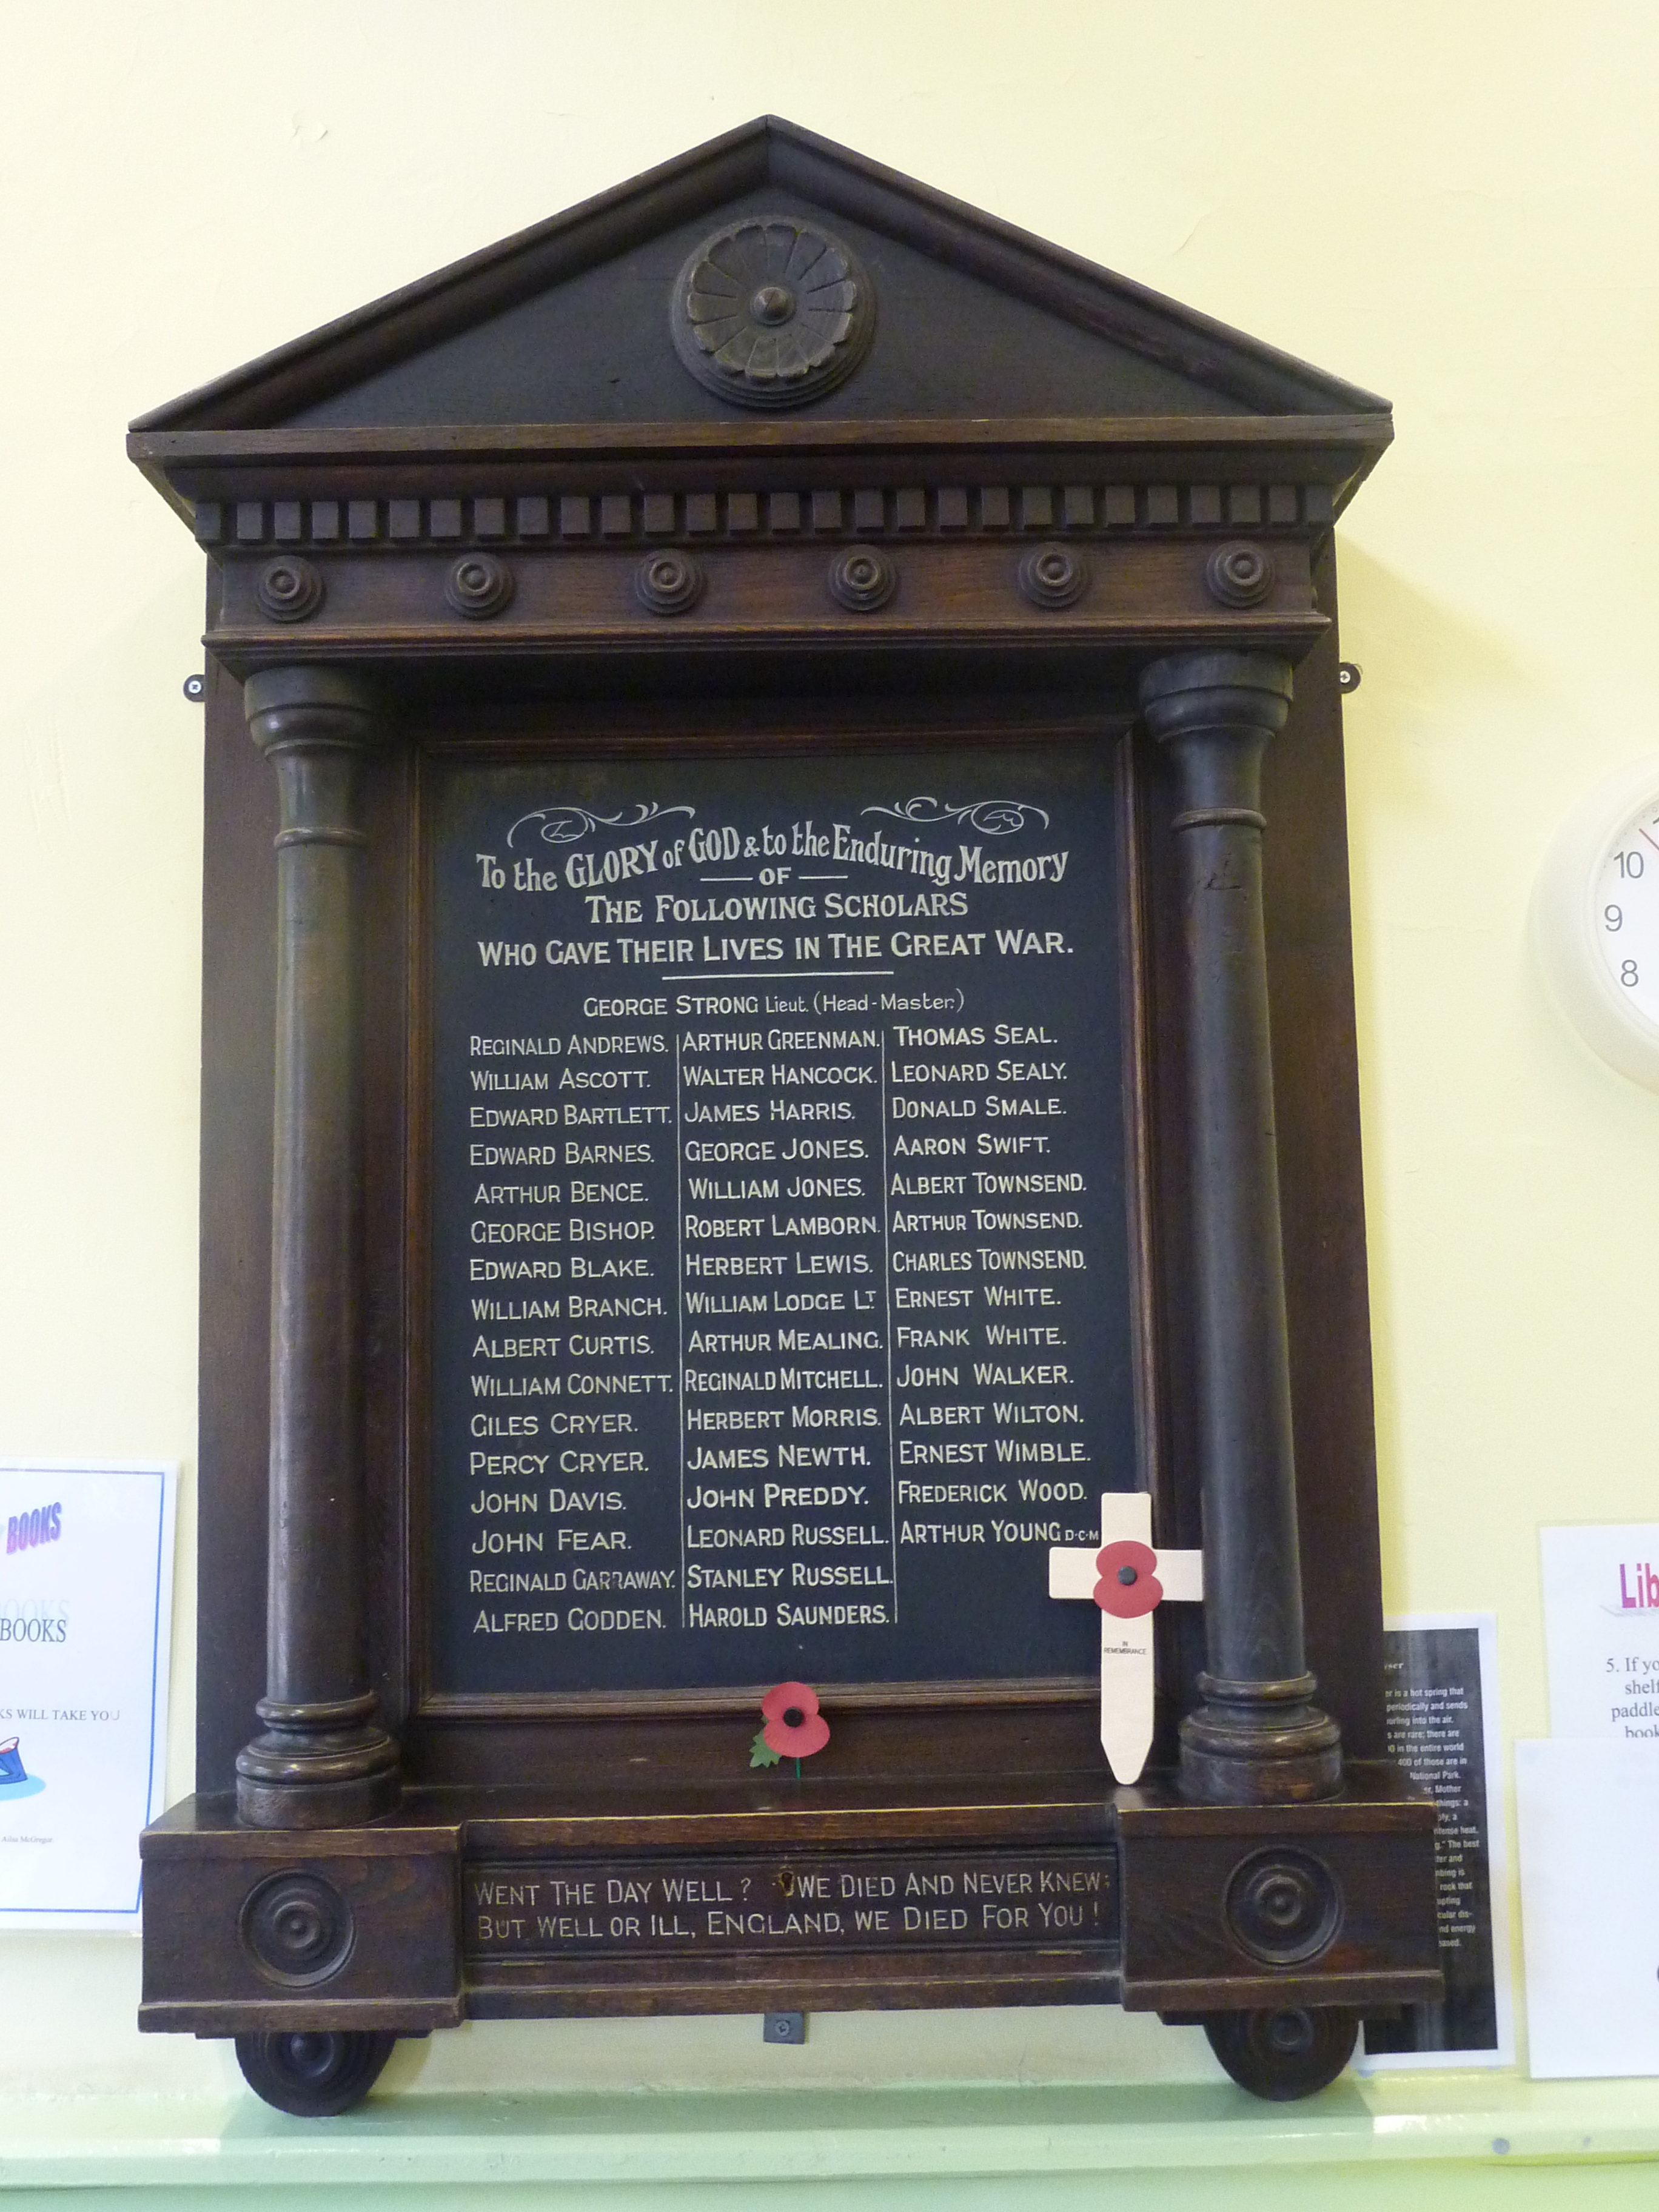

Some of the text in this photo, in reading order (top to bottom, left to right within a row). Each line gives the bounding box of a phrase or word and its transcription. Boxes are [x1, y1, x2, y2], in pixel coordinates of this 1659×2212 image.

[476, 821, 1068, 891] To the GLORY of GOD & to the Enduring Memory
[1614, 851, 1644, 879] 10
[759, 867, 791, 885] OF
[585, 892, 968, 923] THE FOLLOWING SCHOLARS
[1604, 905, 1622, 931] 9
[478, 930, 1073, 966] WHO GAVE THEIR LIVES IN THE GREAT WAR.
[1621, 960, 1638, 987] 8
[584, 997, 668, 1017] GEORGE
[676, 995, 758, 1014] STRONG
[766, 996, 808, 1013] Lieut.
[471, 1034, 668, 1056] REGINALD ANDREWS.
[683, 1029, 880, 1051] ARTHUR GREENMAN.
[893, 1024, 1057, 1046] THOMAS SEAL.
[471, 1068, 650, 1090] WILLIAM ASCOTT.
[683, 1064, 877, 1086] WALTER HANCOCK.
[892, 1060, 1067, 1082] LEONARD SEALY.
[471, 1105, 671, 1127] EDWARD BARTLETT.
[685, 1100, 855, 1122] JAMES HARRIS.
[893, 1096, 1066, 1118] DONALD SMALE.
[471, 1142, 654, 1165] EDWARD BARNES.
[685, 1138, 868, 1161] GEORGE JONES.
[894, 1133, 1050, 1156] AARON SWIFT.
[475, 1181, 648, 1204] ARTHUR BENCE.
[689, 1177, 865, 1199] WILLIAM JONES.
[891, 1172, 1086, 1195] ALBERT TOWNSEND.
[471, 1219, 654, 1243] GEORGE BISHOP.
[686, 1215, 880, 1238] ROBERT LAMBORN.
[893, 1210, 1082, 1232] ARTHUR TOWNSEND.
[470, 1258, 654, 1281] EDWARD BLAKE.
[686, 1252, 873, 1275] HERBERT LEWIS.
[893, 1249, 1086, 1272] CHARLES TOWNSEND.
[472, 1296, 667, 1320] WILLIAM BRANCH.
[686, 1292, 767, 1313] WILLIAM
[774, 1292, 845, 1311] LODGE
[896, 1286, 1061, 1308] ERNEST WHITE.
[473, 1335, 654, 1358] ALBERT CURTIS.
[689, 1329, 883, 1352] ARTHUR MEALING.
[897, 1325, 1066, 1347] FRANK WHITE.
[471, 1373, 672, 1396] WILLIAM CONNETT.
[686, 1368, 882, 1391] REGINALD MITCHELL.
[897, 1364, 1073, 1387] JOHN WALKER.
[471, 1413, 637, 1436] GILES CRYER.
[688, 1406, 881, 1430] HERBERT MORRIS.
[900, 1403, 1084, 1426] ALBERT WILTON.
[471, 1450, 648, 1475] PERCY CRYER.
[688, 1445, 870, 1469] JAMES NEWTH.
[900, 1439, 1090, 1464] ERNEST WIMBLE.
[471, 1489, 626, 1513] JOHN DAVIS.
[687, 1484, 868, 1509] JOHN PREDDY.
[899, 1480, 1087, 1504] FREDERICK WOOD.
[6, 1501, 62, 1555] BOOKS
[688, 1524, 889, 1548] LEONARD RUSSELL.
[900, 1521, 985, 1543] ARTHUR
[991, 1520, 1061, 1542] YOUNG
[472, 1529, 631, 1553] JOHN FEAR.
[471, 1570, 566, 1592] REGINALD
[688, 1563, 893, 1587] STANLEY RUSSELL.
[1620, 1563, 1659, 1608] Lib
[474, 1607, 666, 1632] ALFRED GODDEN.
[689, 1603, 889, 1627] HAROLD SAUNDERS.
[0, 1618, 67, 1643] BOOKS
[1606, 1658, 1620, 1672] 5.
[1625, 1657, 1638, 1672] If
[1424, 1688, 1447, 1698] spring
[1449, 1687, 1464, 1695] that
[17, 1709, 48, 1720] WILL
[52, 1710, 87, 1720] TAKE
[475, 1882, 540, 1905] WENT
[550, 1881, 595, 1905] THE
[608, 1880, 652, 1903] DAY
[797, 1875, 830, 1898] WE
[841, 1875, 895, 1897] DIED
[905, 1872, 954, 1895] AND
[964, 1872, 1032, 1894] NEVER
[479, 1916, 526, 1939] BUT
[537, 1917, 603, 1937] WELL
[611, 1917, 640, 1936] OR
[651, 1915, 695, 1938] ILL,
[708, 1911, 844, 1935] ENGLAND,
[855, 1911, 889, 1930] WE
[904, 1906, 967, 1930] DIED
[984, 1905, 1028, 1928] FOR
